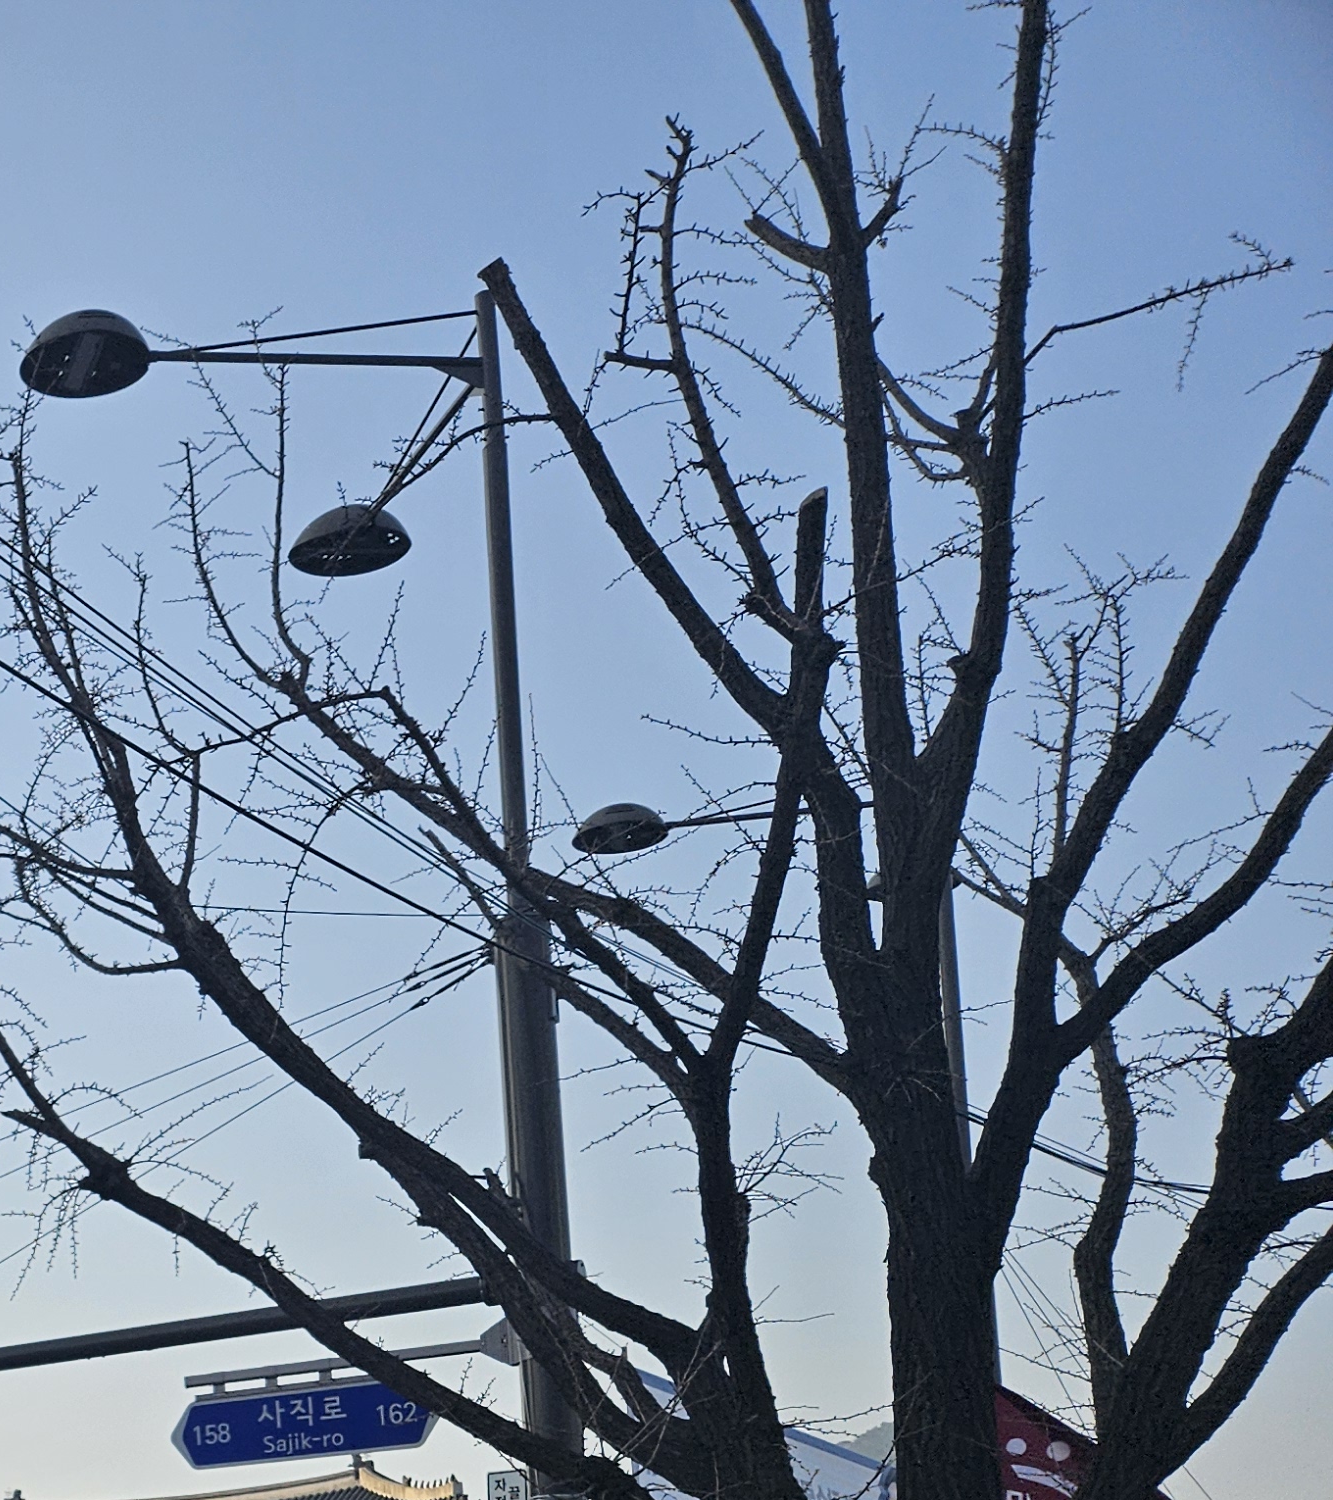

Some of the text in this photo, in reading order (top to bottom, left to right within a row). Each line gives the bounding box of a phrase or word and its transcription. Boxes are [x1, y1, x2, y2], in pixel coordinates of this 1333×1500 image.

[257, 1395, 347, 1429] 사직로
[375, 1401, 417, 1426] 162
[192, 1423, 231, 1446] 158
[263, 1432, 344, 1456] Sajik-ro
